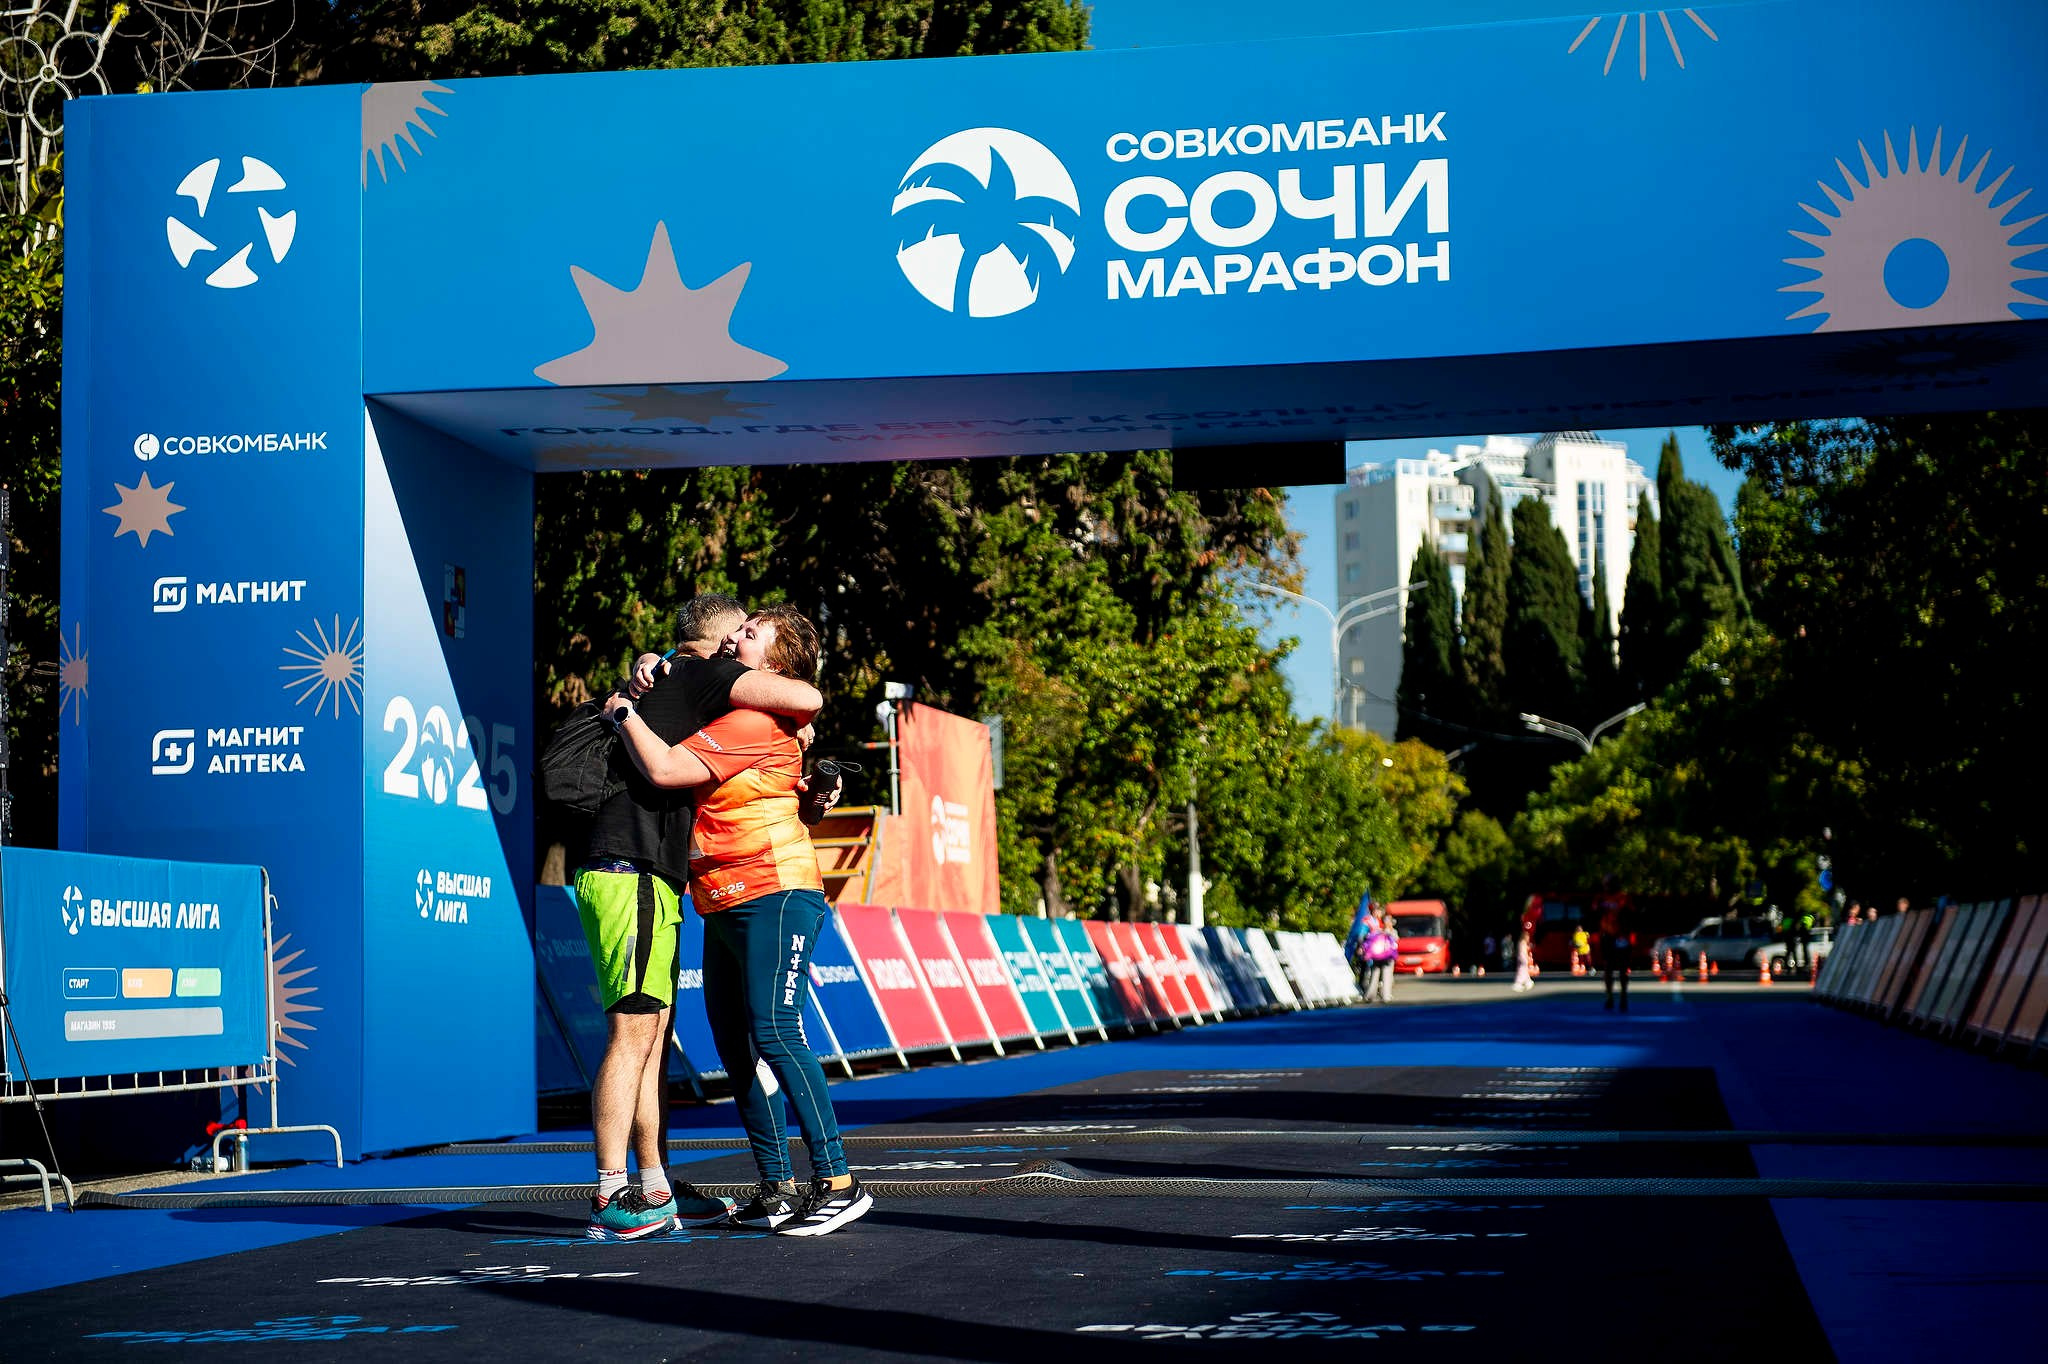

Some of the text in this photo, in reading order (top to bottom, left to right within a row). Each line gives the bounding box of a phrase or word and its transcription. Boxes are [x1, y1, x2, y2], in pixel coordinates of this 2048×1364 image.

[1105, 111, 1447, 163] СОВКОМБАНК
[1104, 158, 1449, 252] СОЧИ
[1107, 240, 1450, 300] МАРАФОН
[163, 431, 328, 456] СОВКОМБАНК
[197, 580, 306, 604] МАГНИТ
[207, 726, 304, 747] МАГНИТ
[207, 752, 305, 774] АПТЕКА
[436, 871, 491, 898] ВЫСШАЯ
[90, 898, 221, 930] ВЫСШАЯ ЛИГА
[435, 897, 468, 924] ЛИГА
[68, 978, 90, 989] СТАРТ
